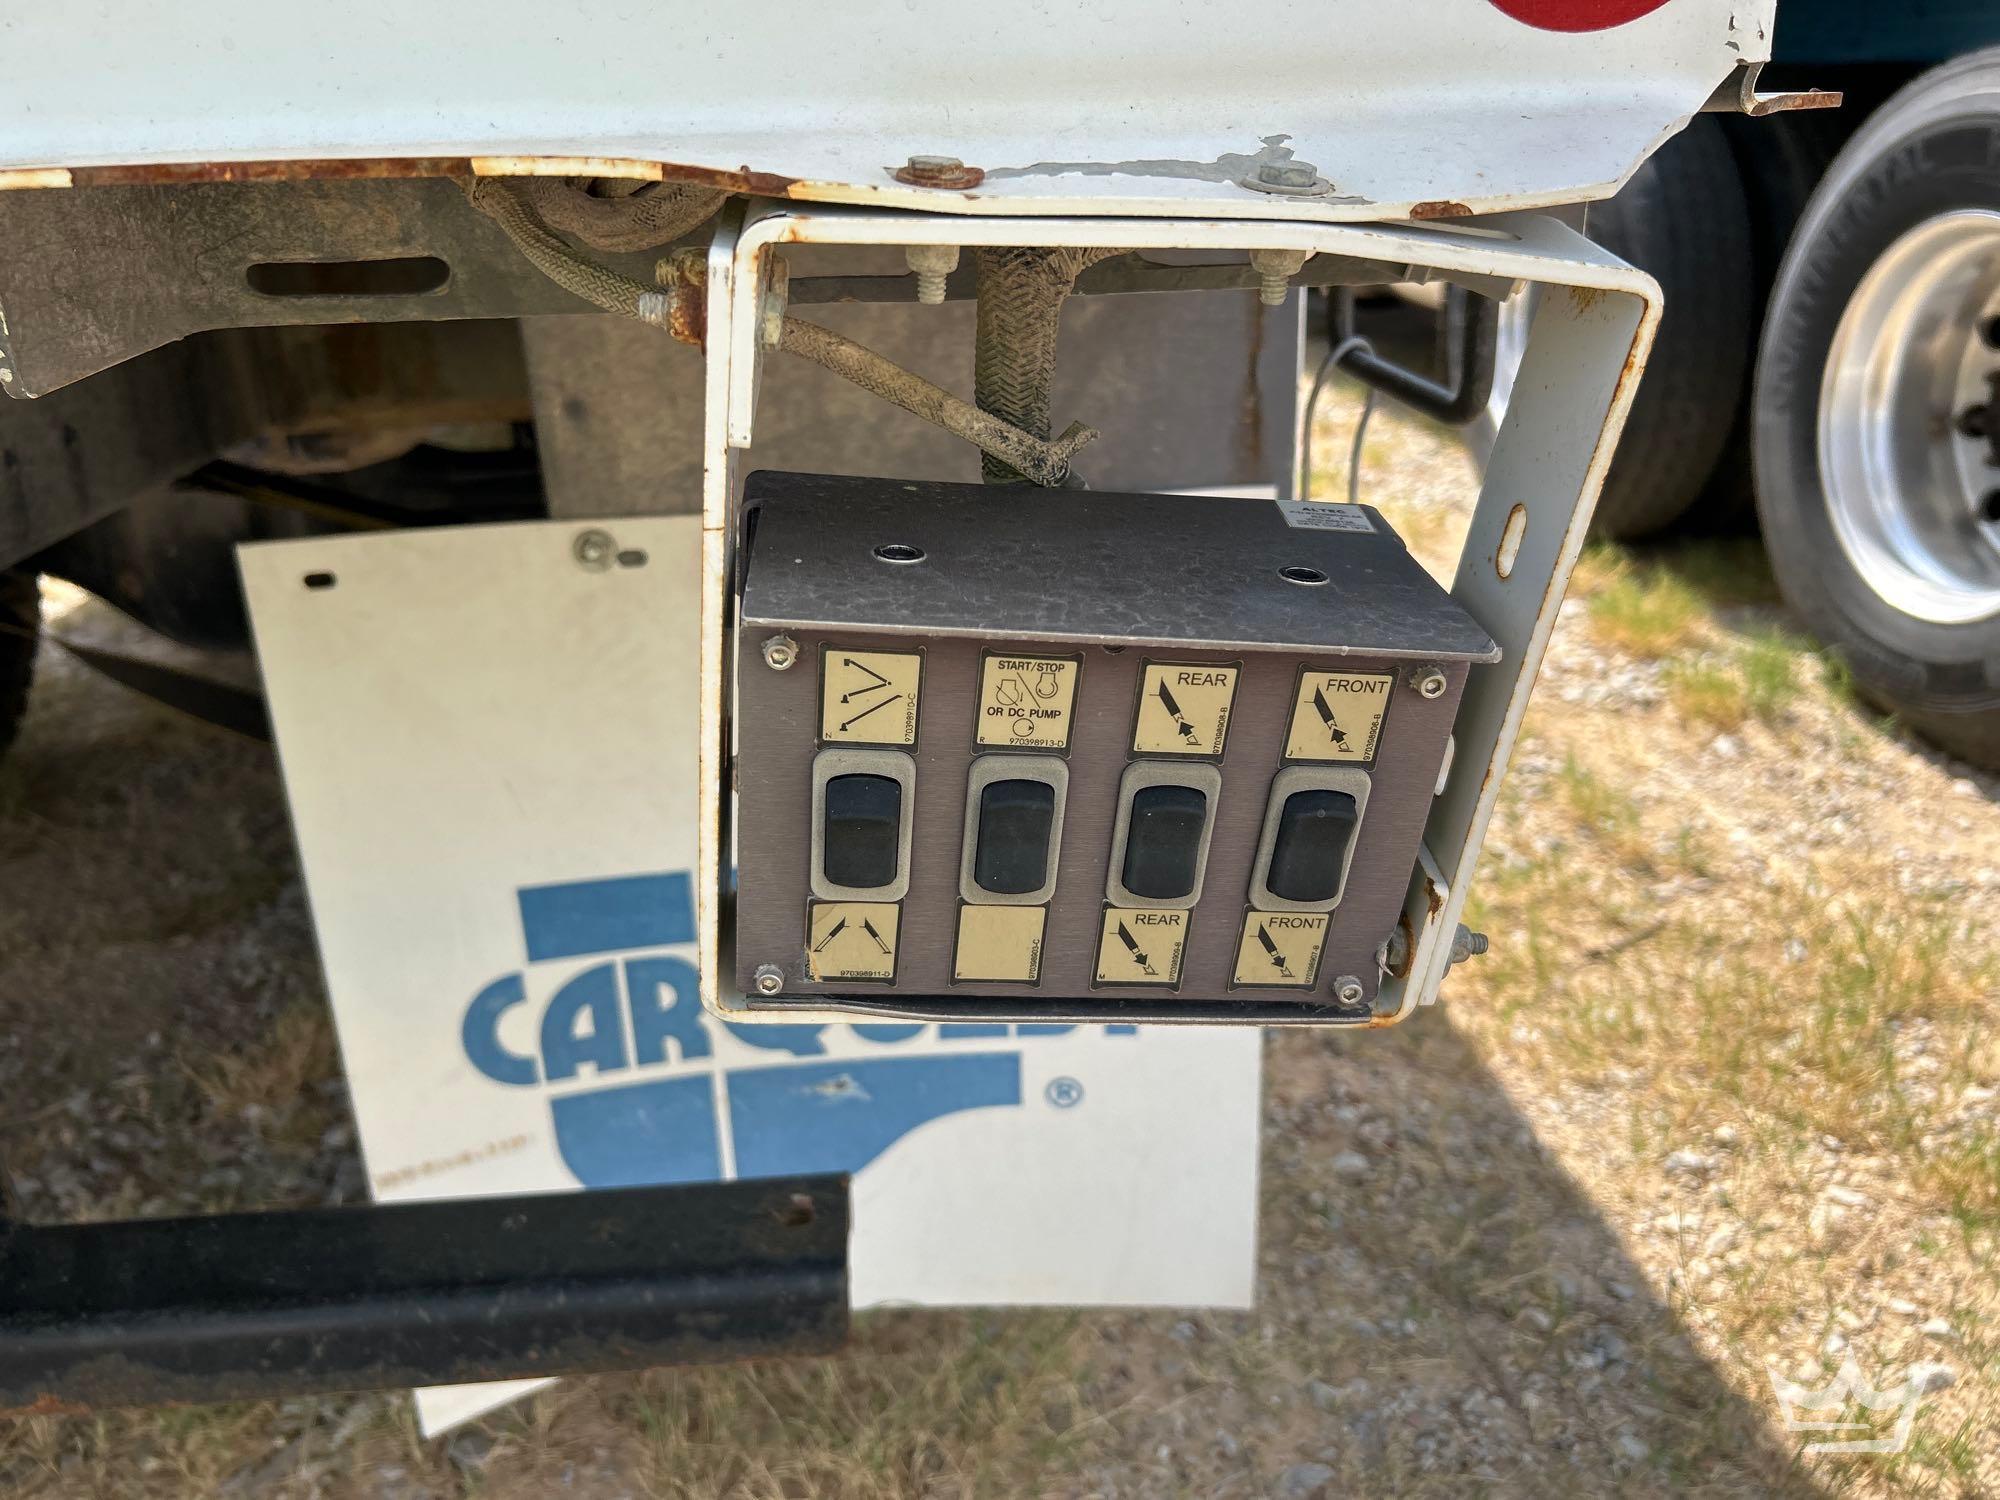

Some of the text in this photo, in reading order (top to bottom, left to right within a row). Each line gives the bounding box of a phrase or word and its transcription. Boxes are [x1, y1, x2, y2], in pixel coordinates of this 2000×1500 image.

[998, 660, 1065, 673] START/STOP
[1177, 672, 1227, 687] REAR
[1326, 679, 1389, 694] FRONT
[987, 706, 1062, 719] OR DC PUMP
[1009, 737, 1064, 747] 970398913-D
[1135, 914, 1180, 925] REAR
[1268, 917, 1326, 929] FRONT
